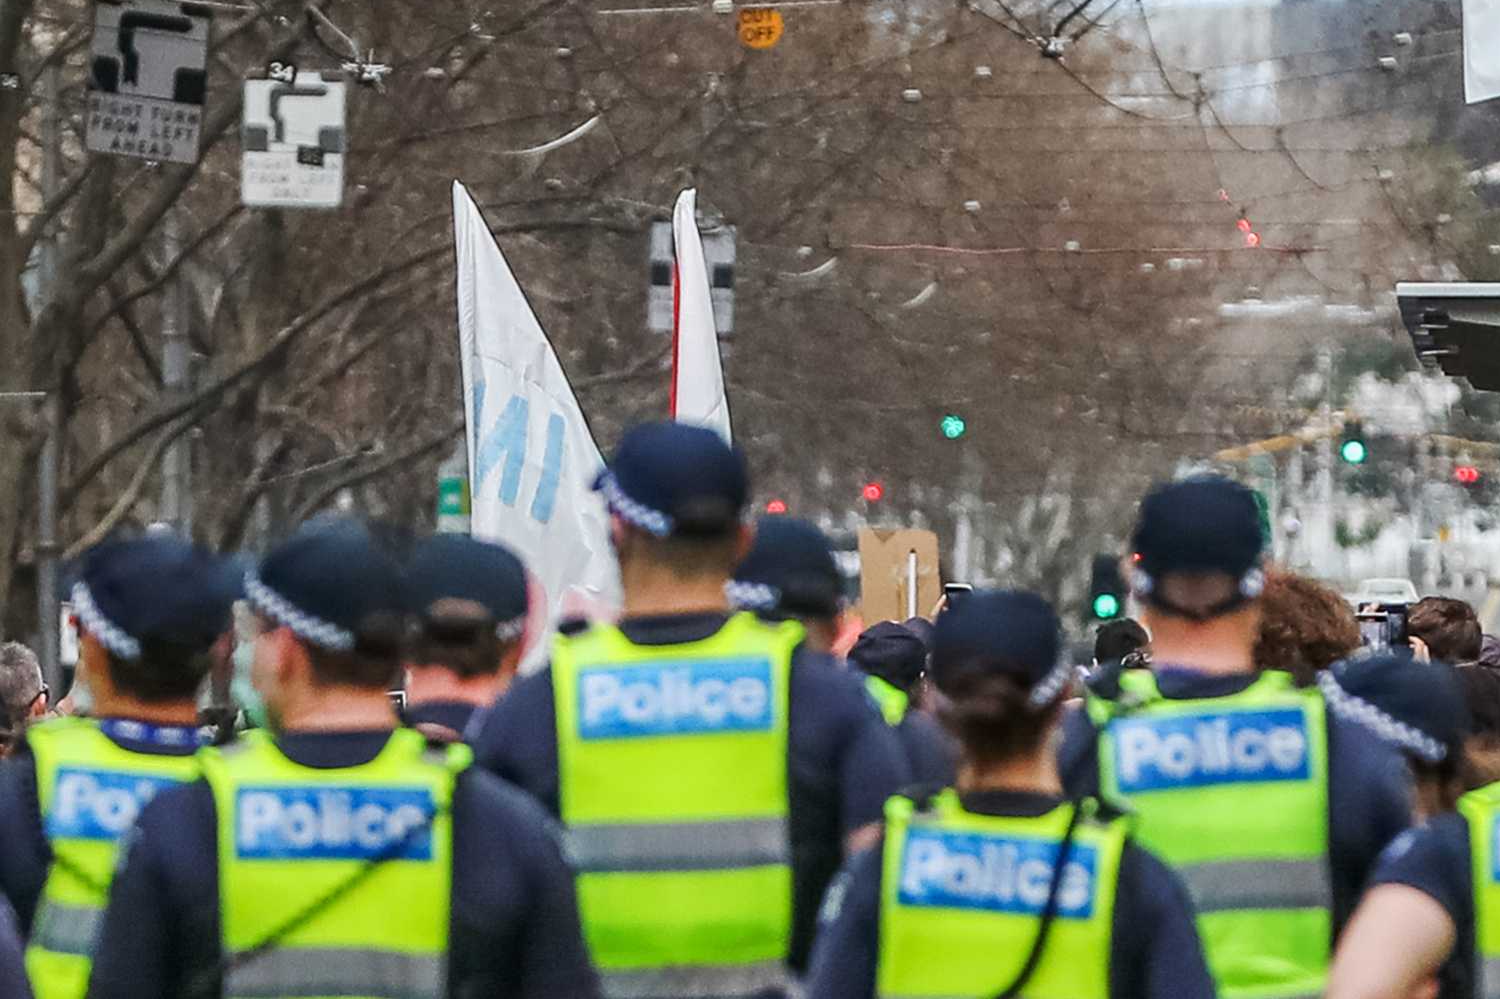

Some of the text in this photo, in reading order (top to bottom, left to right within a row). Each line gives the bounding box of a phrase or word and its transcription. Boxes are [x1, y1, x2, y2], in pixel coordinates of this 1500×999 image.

[269, 61, 295, 82] 34
[110, 135, 173, 157] AHEAD
[150, 123, 194, 140] LEFT
[579, 667, 769, 727] Police
[1117, 718, 1304, 781] Police
[902, 836, 1091, 910] Police
